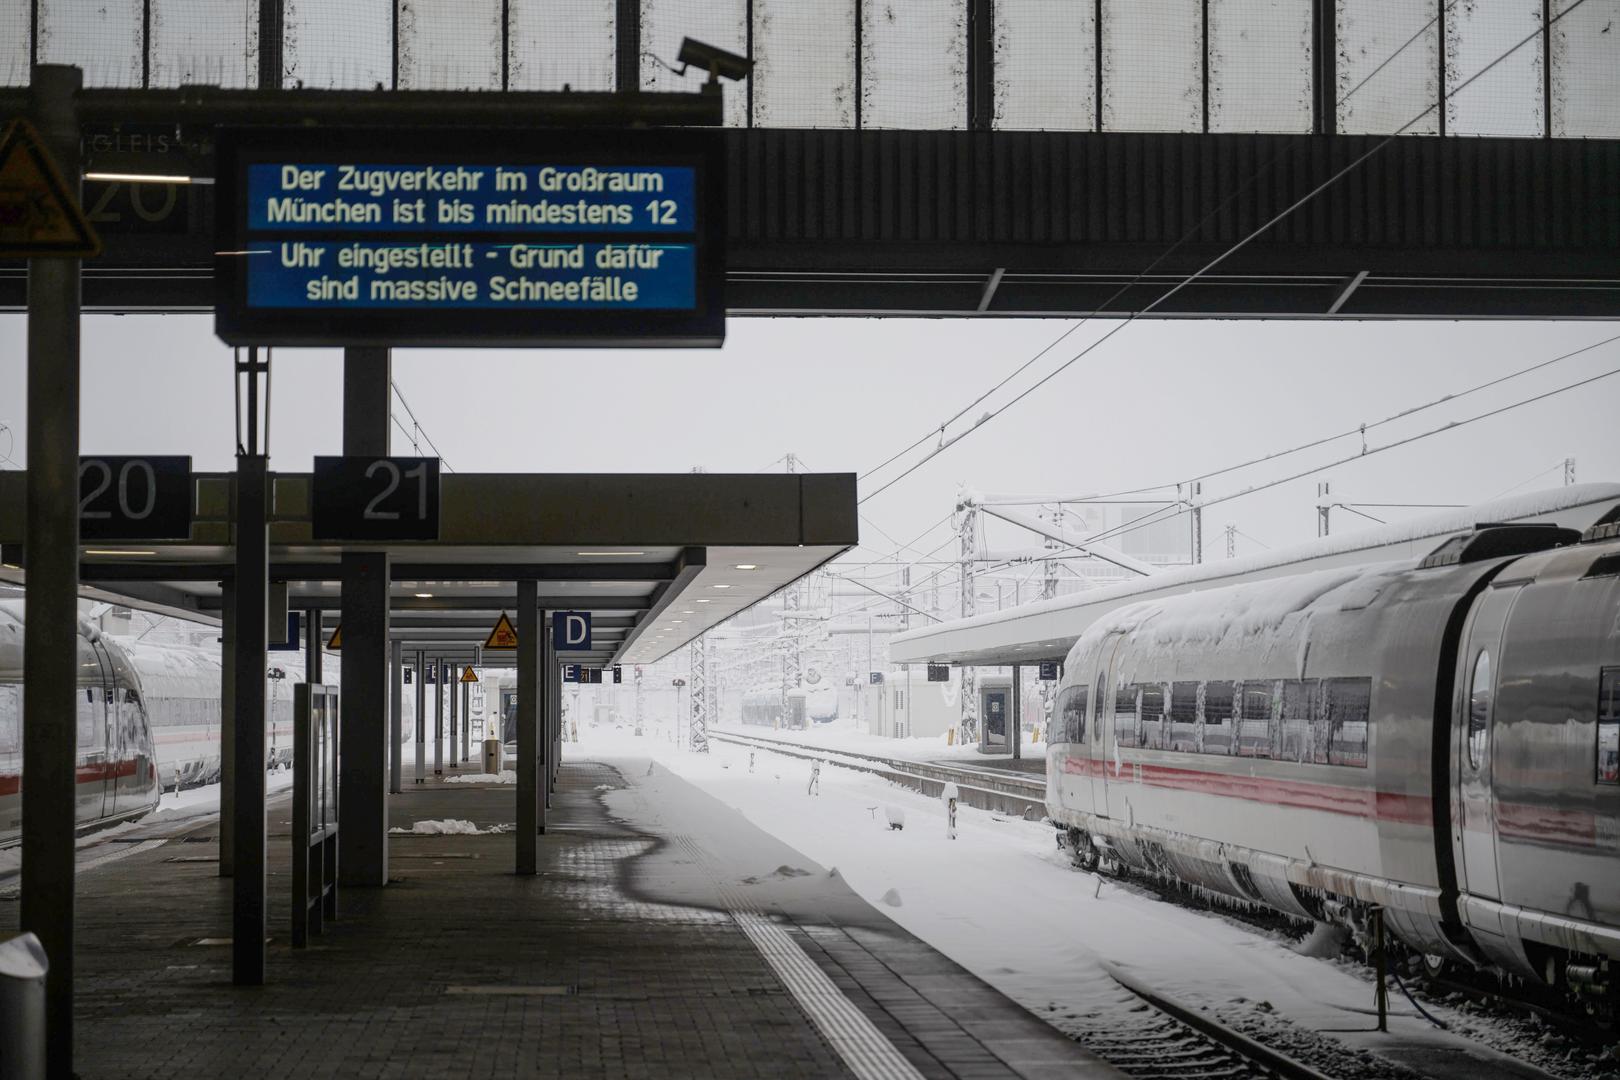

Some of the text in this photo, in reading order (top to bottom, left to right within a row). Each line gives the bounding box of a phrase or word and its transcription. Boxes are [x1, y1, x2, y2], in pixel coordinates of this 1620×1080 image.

[281, 165, 663, 195] Der Zugverkehr im Großraum
[267, 198, 677, 225] München ist bis mindestens 12
[281, 244, 325, 268] Uhr
[338, 244, 473, 273] eingestellt
[510, 245, 584, 269] Grund
[595, 245, 664, 269] dafür
[307, 276, 638, 301] sind massive Schneefälle
[80, 459, 156, 519] 20
[363, 460, 428, 520] 21
[566, 615, 587, 645] D
[565, 665, 575, 679] E
[1041, 663, 1051, 677] E
